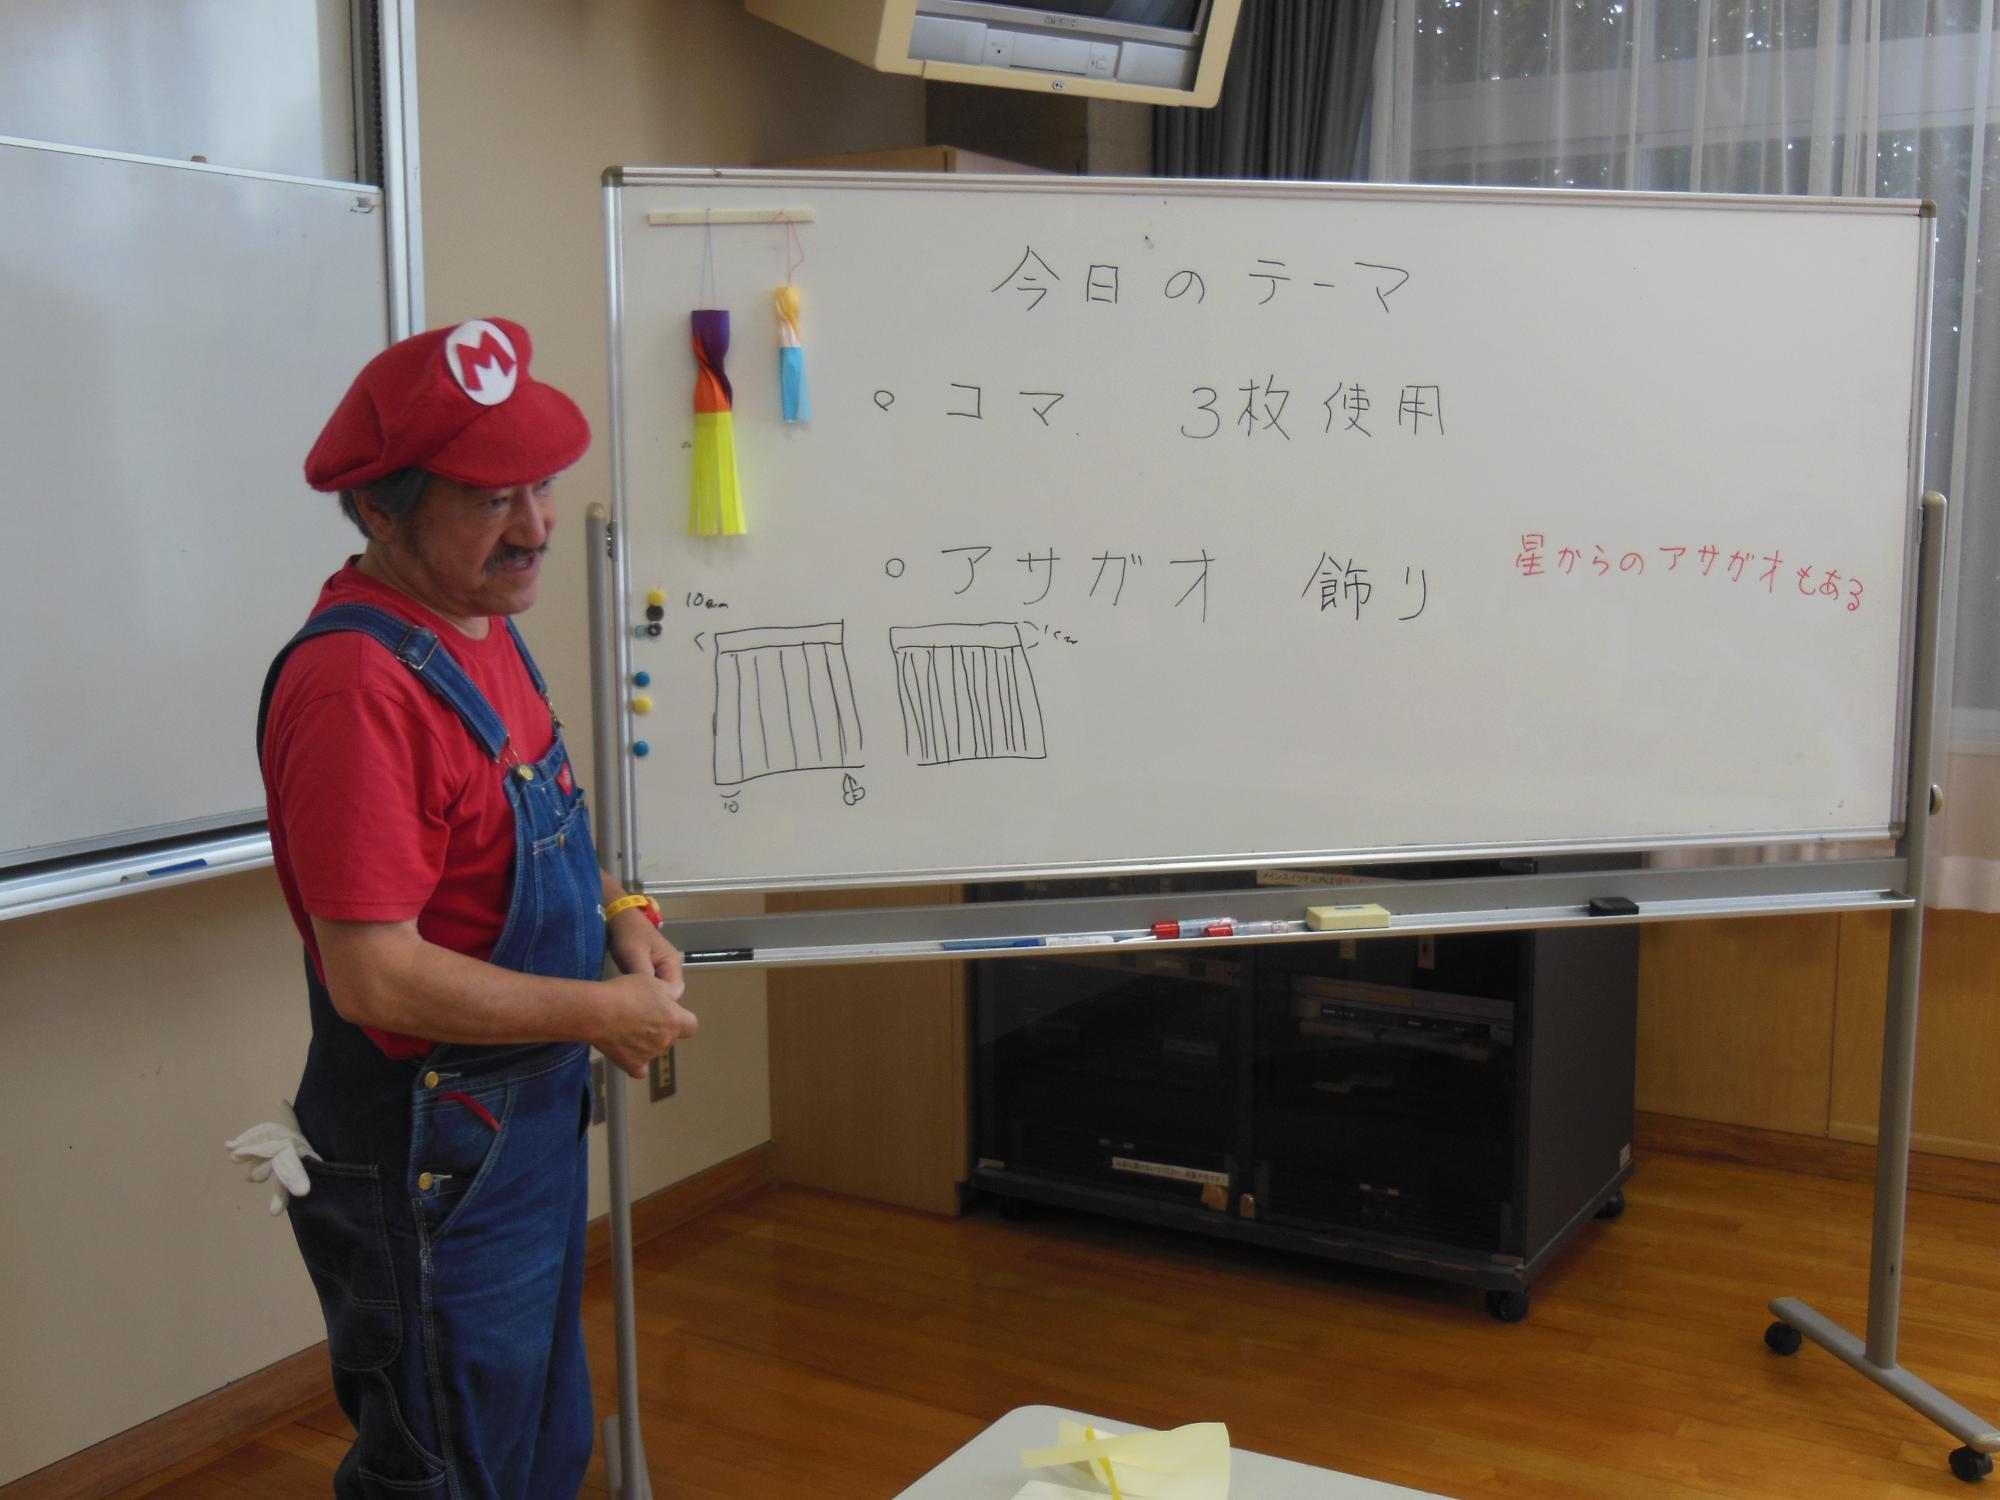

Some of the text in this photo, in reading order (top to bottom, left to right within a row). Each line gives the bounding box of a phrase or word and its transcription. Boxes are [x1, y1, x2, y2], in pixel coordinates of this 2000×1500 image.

[991, 244, 1410, 313] 今日のテーマ
[455, 329, 516, 391] M
[946, 373, 1445, 441] コマ 3枚使用
[940, 545, 1427, 623] アサガオ 飾り
[1514, 532, 1864, 612] 星からのアサガオもある
